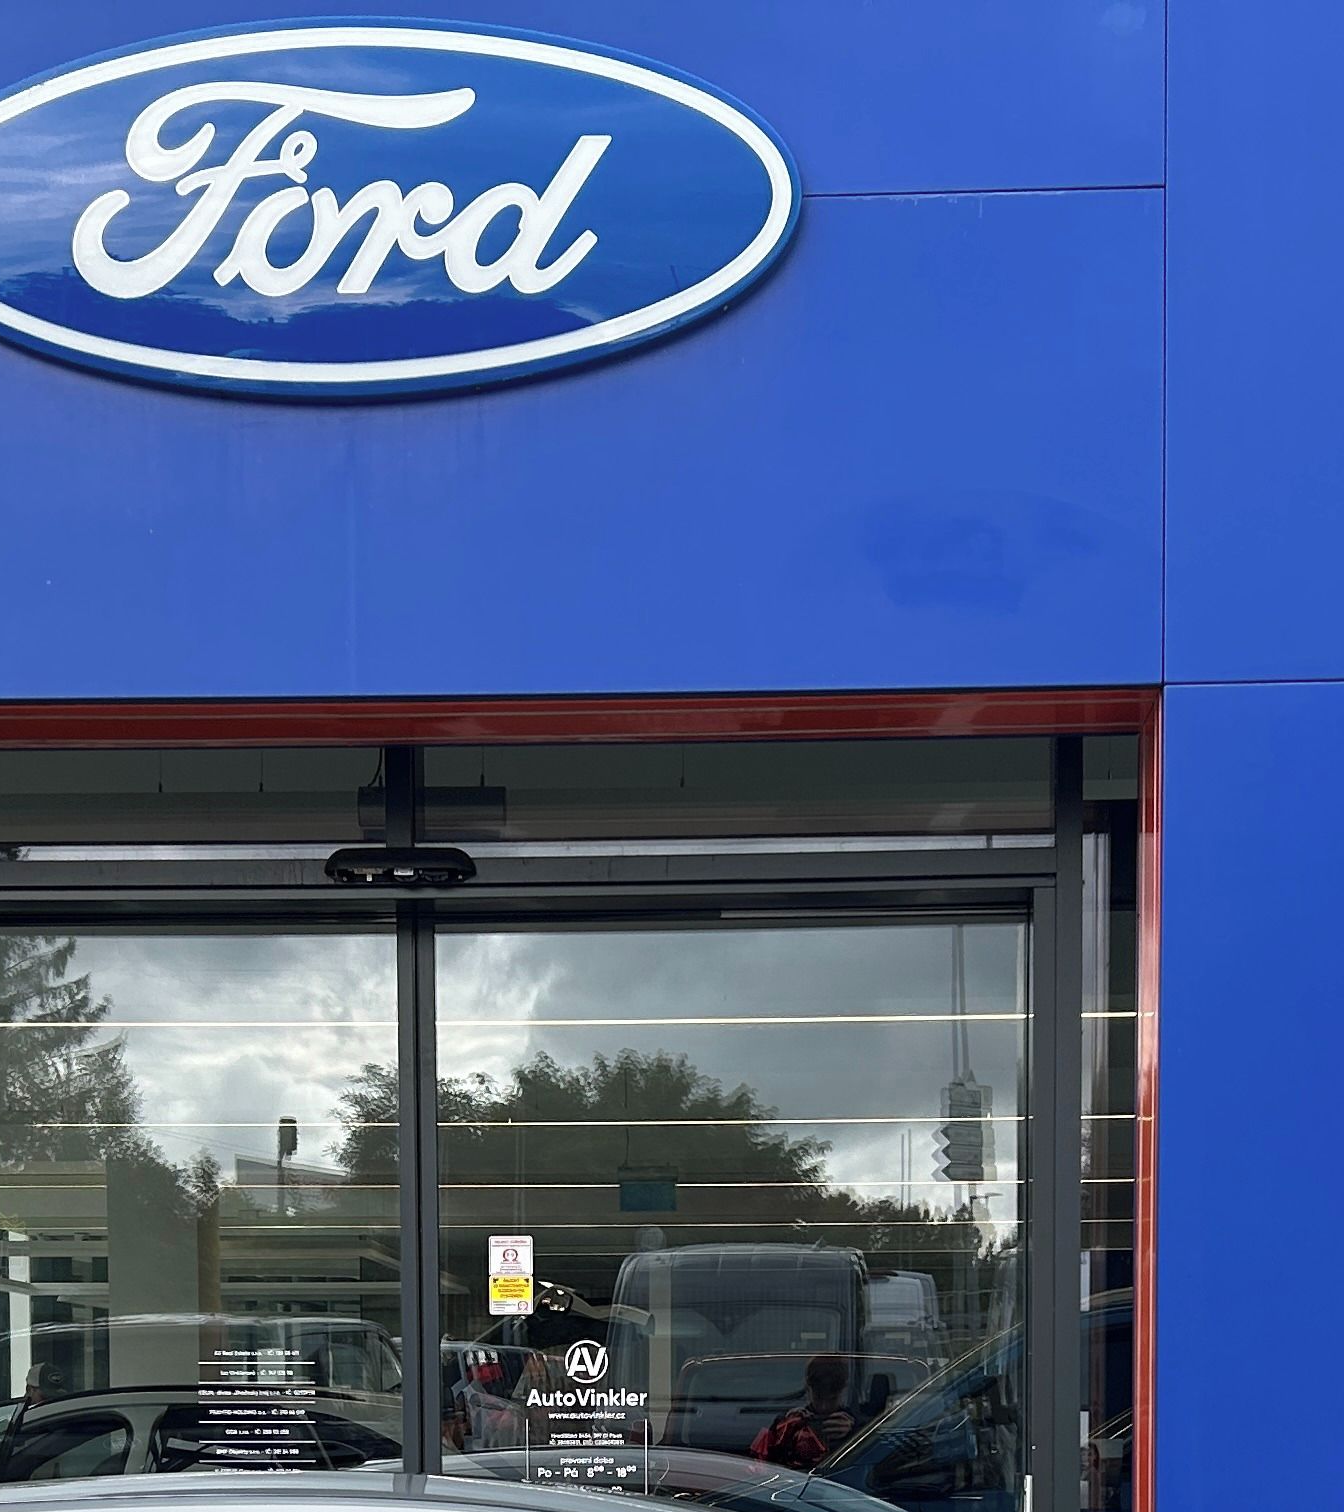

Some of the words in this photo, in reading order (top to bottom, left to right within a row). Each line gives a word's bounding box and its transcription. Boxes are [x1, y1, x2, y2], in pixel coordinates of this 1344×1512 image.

[71, 80, 613, 299] Ford
[566, 1346, 608, 1377] AV
[526, 1388, 648, 1407] AutoVinkler
[537, 1467, 552, 1478] Po
